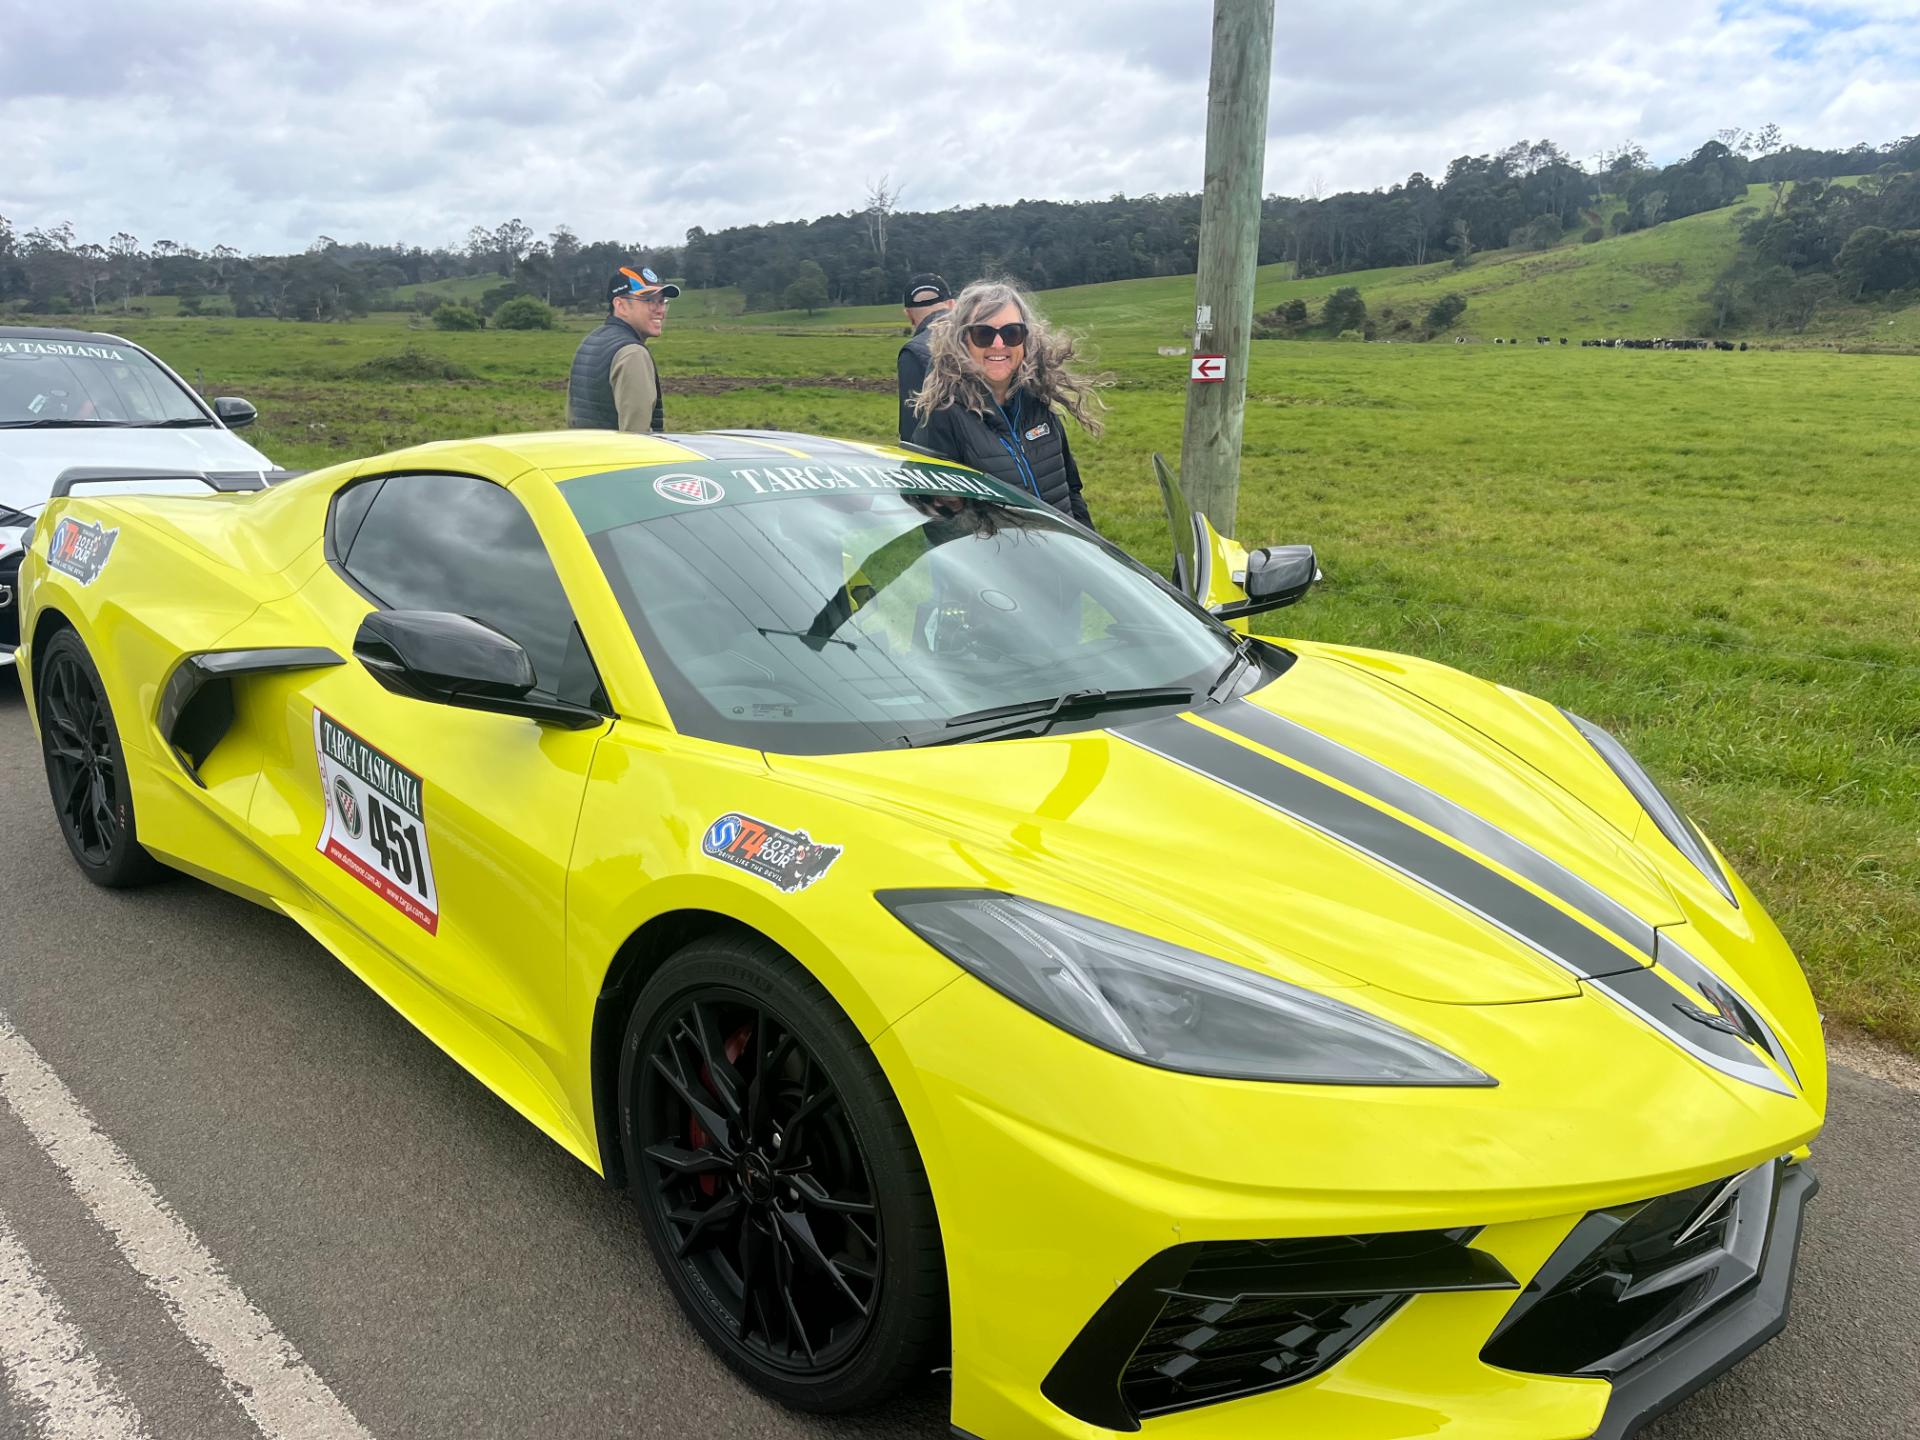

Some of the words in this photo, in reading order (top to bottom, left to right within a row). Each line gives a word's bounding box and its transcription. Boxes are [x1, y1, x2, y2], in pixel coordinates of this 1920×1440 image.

[18, 342, 124, 361] TASMANIA
[733, 465, 850, 494] TARGA
[847, 467, 1004, 499] TASMANIA
[72, 546, 90, 564] TOUR
[324, 721, 360, 767] TARGA
[359, 746, 420, 816] TASMANIA
[367, 792, 429, 900] 451
[728, 818, 768, 861] T4
[763, 836, 796, 857] 2025
[718, 849, 735, 862] DRIVE
[735, 855, 749, 868] LIKE
[750, 860, 763, 873] THE
[763, 867, 783, 882] DEVIL
[756, 845, 791, 869] TOUR
[386, 887, 431, 925] www.targa.com.au
